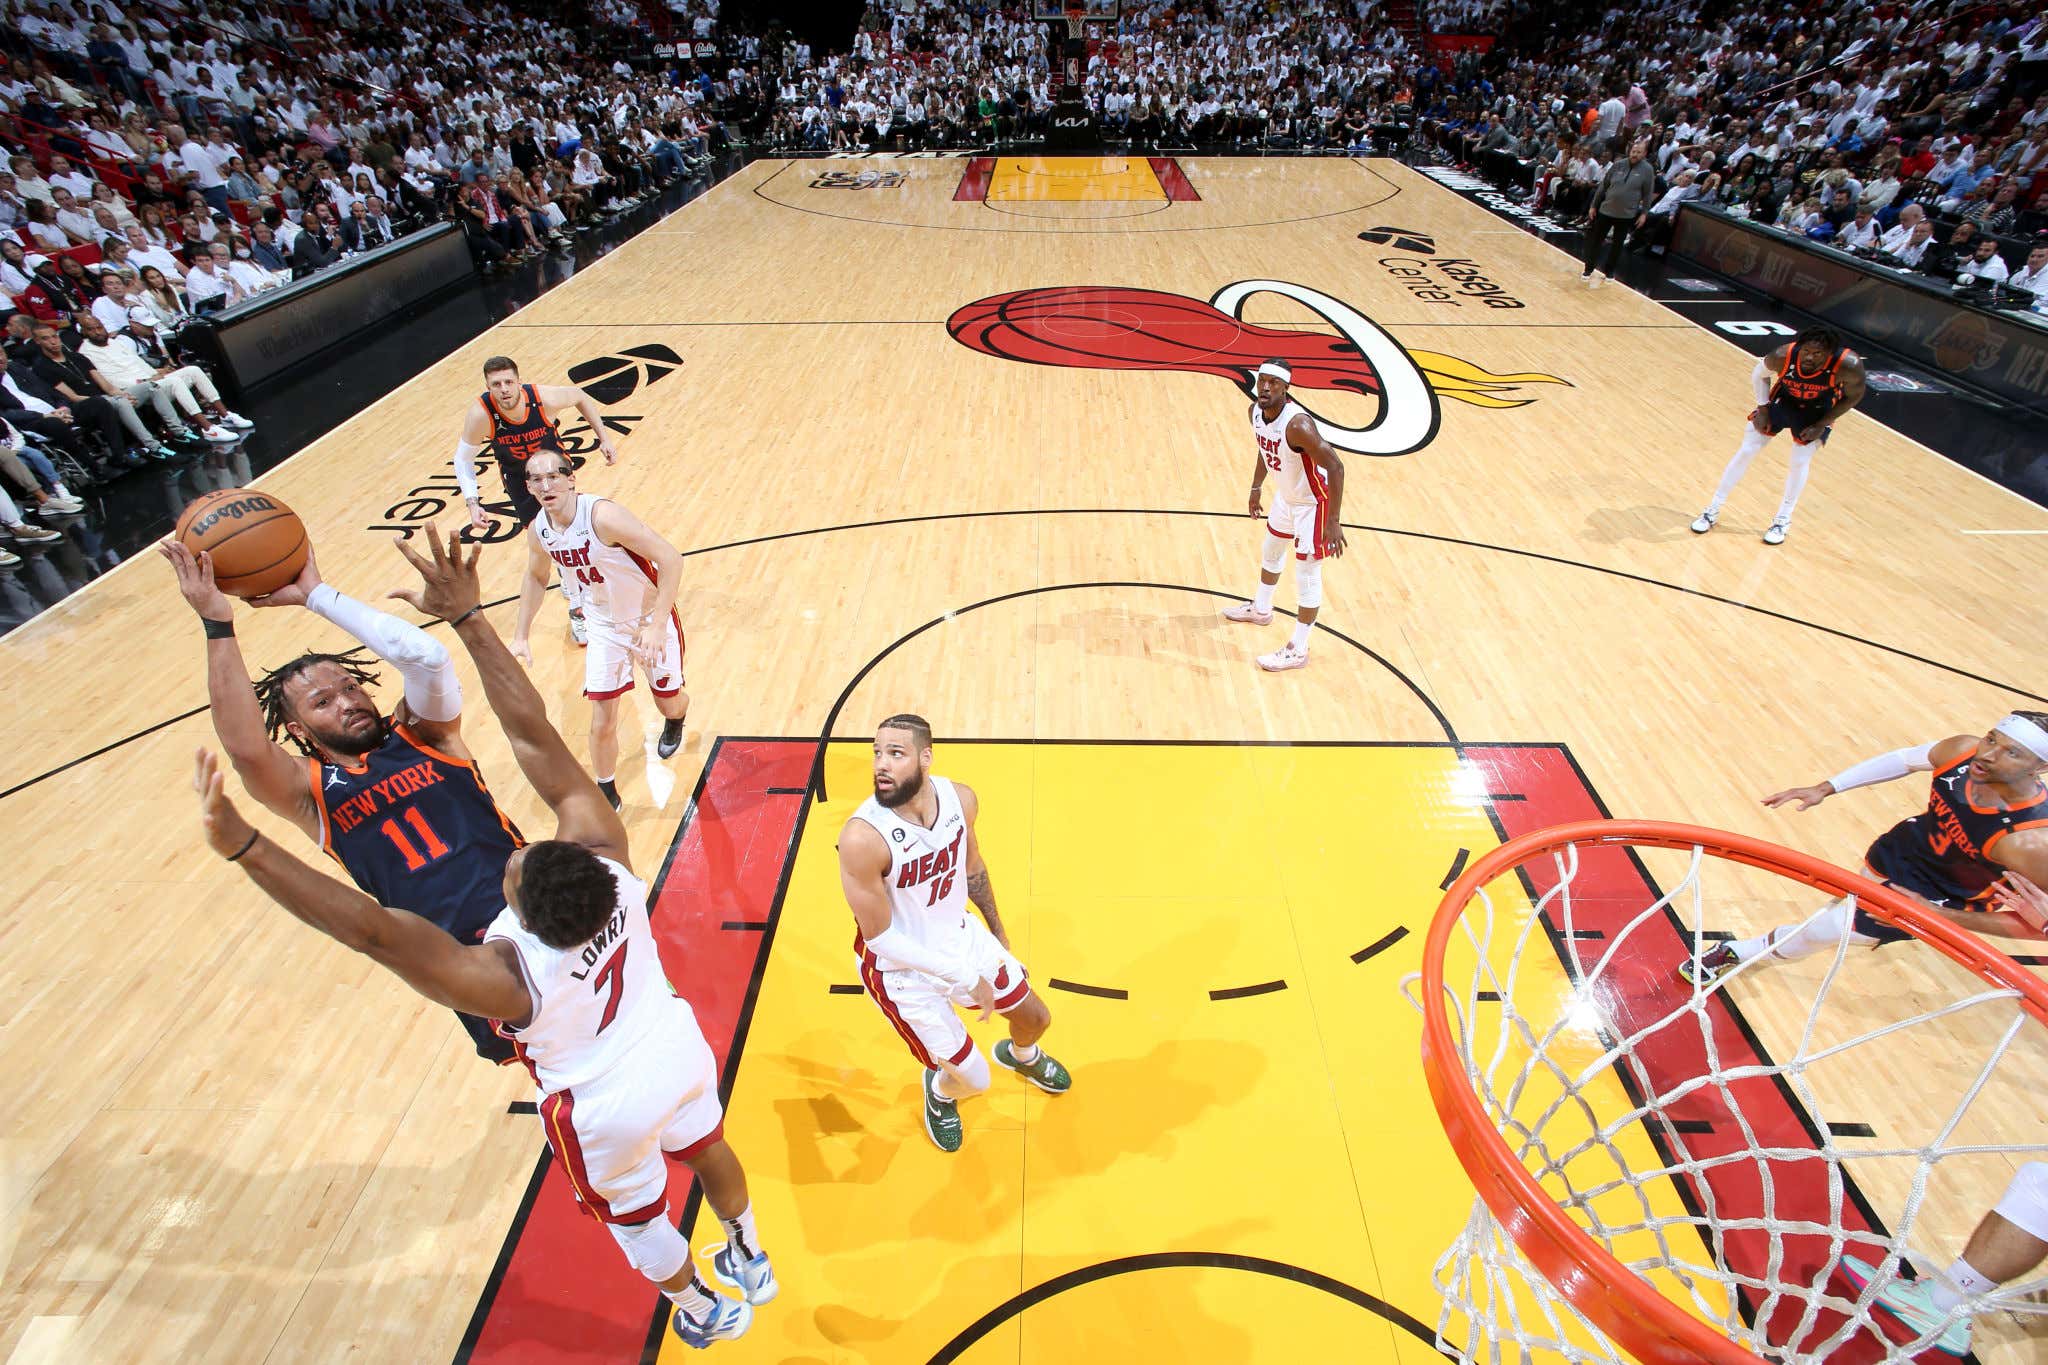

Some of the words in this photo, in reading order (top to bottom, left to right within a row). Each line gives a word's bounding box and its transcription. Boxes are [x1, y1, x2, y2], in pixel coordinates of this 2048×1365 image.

[1055, 118, 1089, 127] KIA
[1475, 192, 1532, 215] Google
[1518, 216, 1578, 232] Pixel
[1378, 258, 1463, 307] Center
[1429, 259, 1526, 309] Kaseya
[1714, 321, 1798, 336] 6
[1790, 388, 1819, 399] 30
[497, 433, 522, 446] NEW
[522, 426, 548, 442] YORK
[509, 441, 542, 460] 55
[1256, 432, 1282, 455] HEAT
[1266, 453, 1282, 472] 22
[191, 496, 277, 536] Wilson
[550, 539, 591, 567] HEAT
[576, 566, 604, 586] 44
[332, 788, 378, 834] NEW
[371, 759, 445, 804] YORK
[381, 805, 449, 872] 11
[1928, 820, 1953, 857] 3
[1944, 813, 1980, 860] YORK
[896, 825, 964, 889] HEAT
[926, 868, 957, 908] 16
[569, 905, 628, 981] LOWRY
[593, 936, 630, 1038] 7
